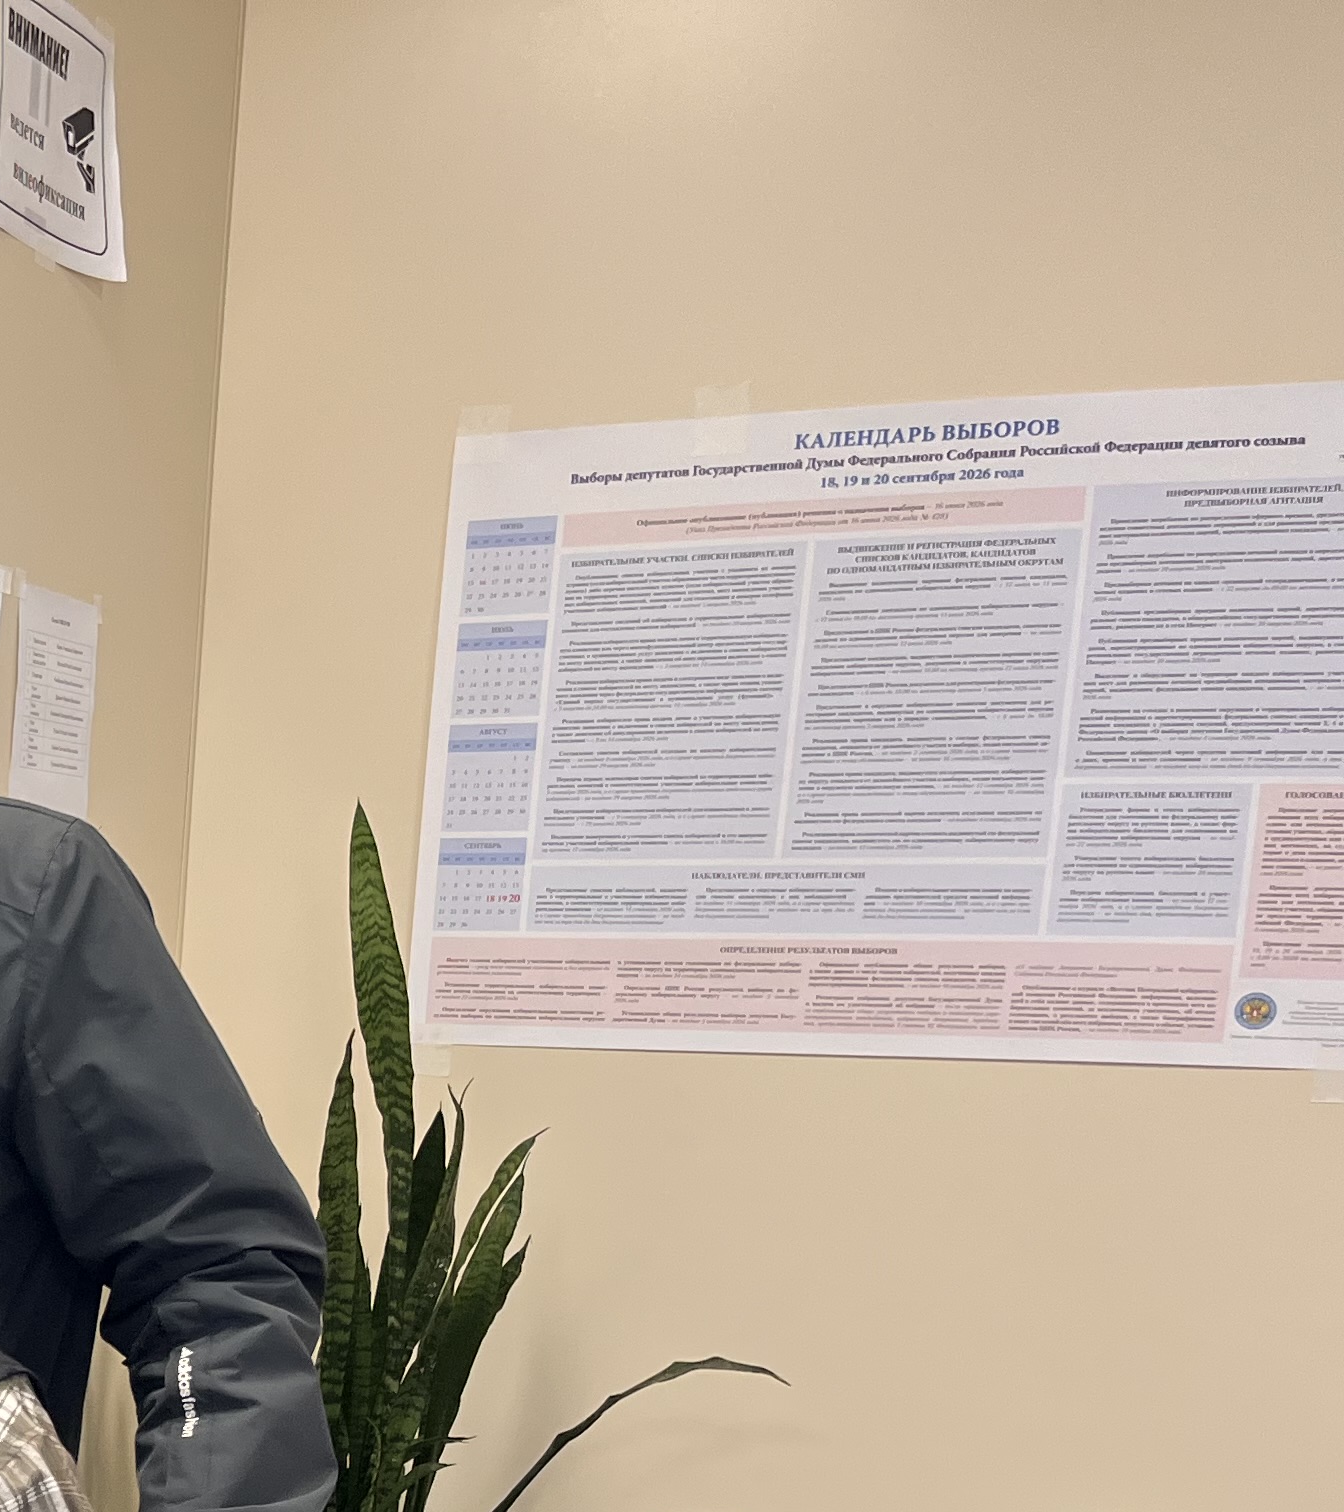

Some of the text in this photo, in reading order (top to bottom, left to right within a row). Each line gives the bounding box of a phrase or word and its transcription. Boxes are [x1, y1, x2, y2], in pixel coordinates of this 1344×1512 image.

[8, 7, 70, 81] ВНИМАНИЕ!
[10, 113, 45, 151] ведется
[13, 162, 85, 221] видеофиксация
[794, 418, 1060, 450] КАЛЕНДАРЬ ВЫБОРОВ
[570, 434, 1306, 486] Выборы депутатов Государственной Думы Федерального Собрания Российской Федерации девятого созыва
[820, 466, 1025, 489] 18, 19 и 20 сентября 2026 года
[479, 728, 508, 737] АВГУСТ
[486, 895, 496, 903] 18
[498, 894, 507, 903] 19
[509, 894, 520, 903] 20
